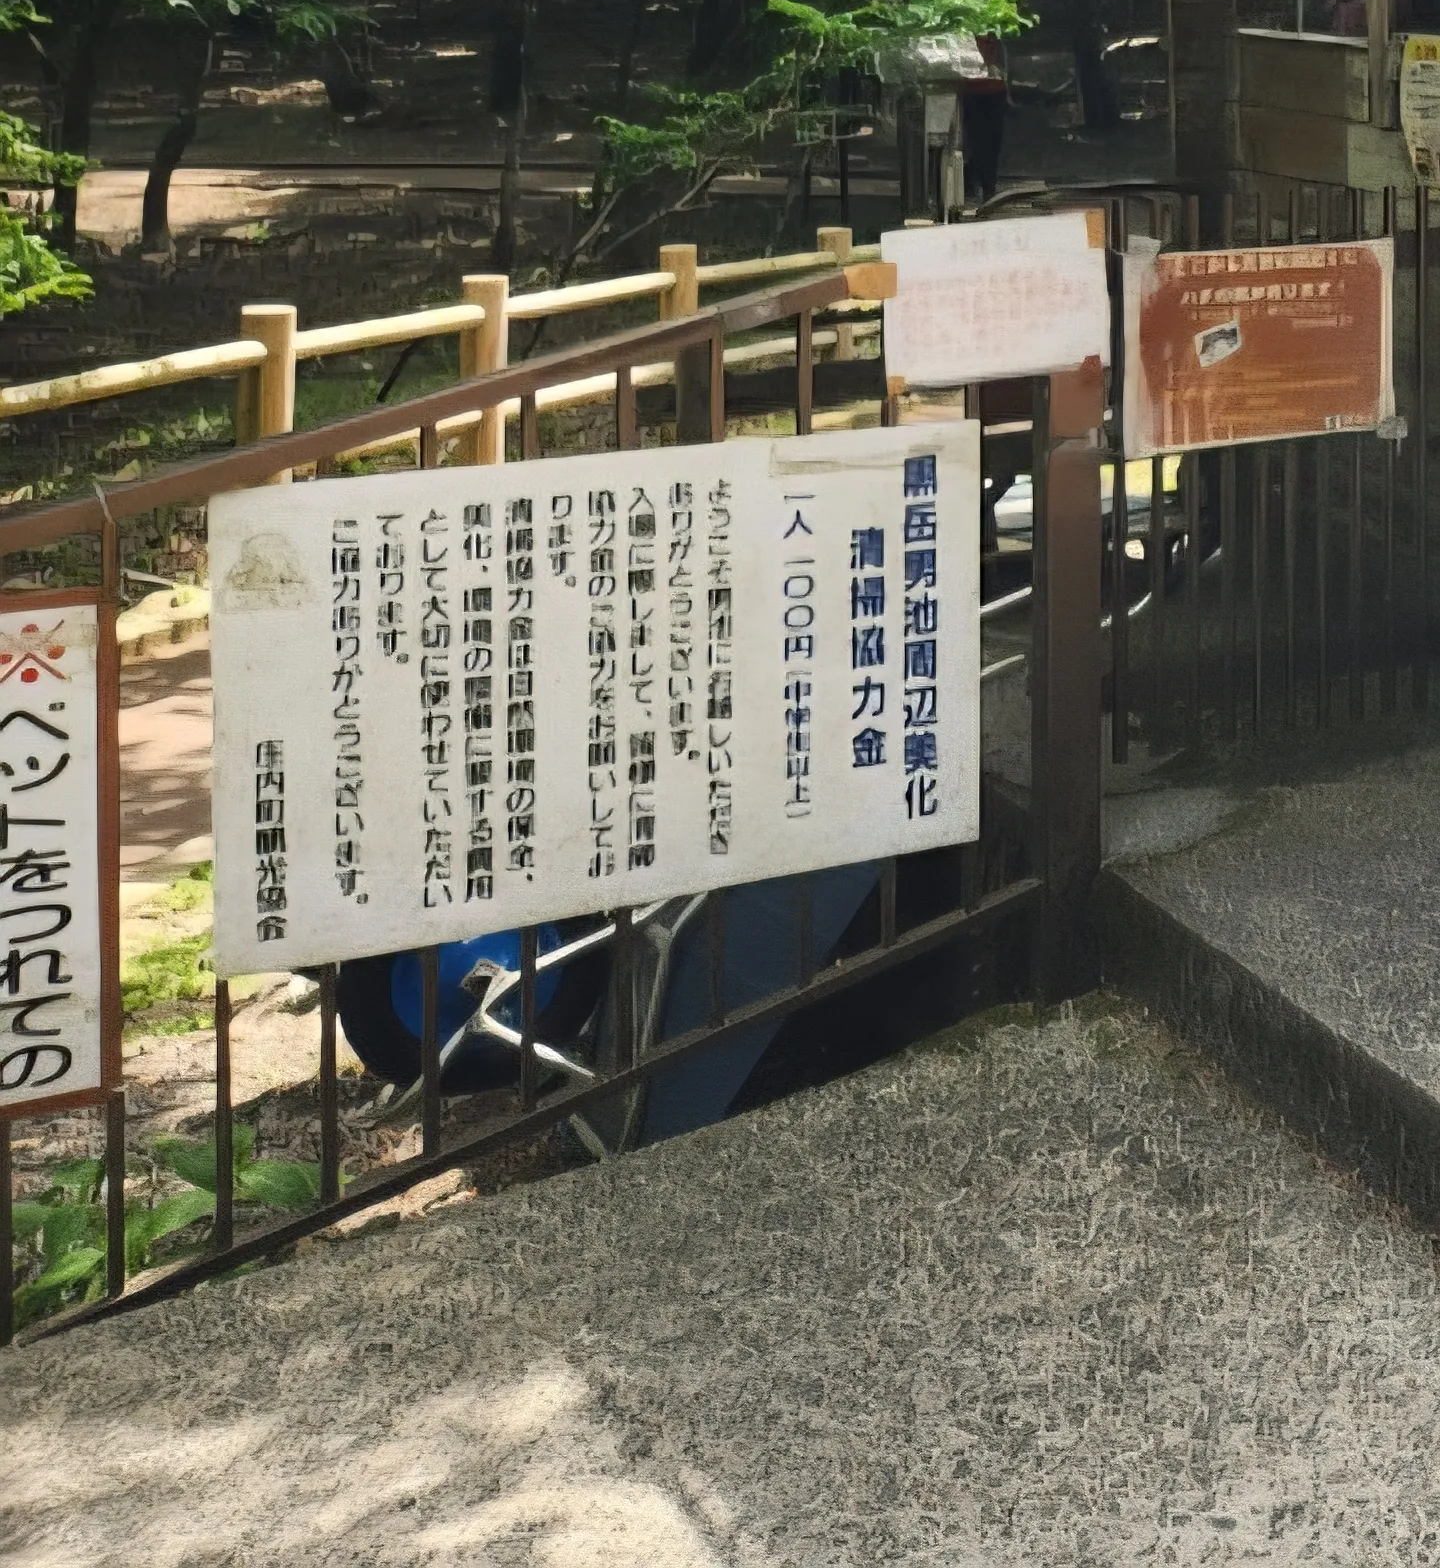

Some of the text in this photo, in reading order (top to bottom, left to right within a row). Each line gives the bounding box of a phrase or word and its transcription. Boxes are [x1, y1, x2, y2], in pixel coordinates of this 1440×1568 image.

[548, 493, 577, 588] ります。
[850, 526, 886, 767] 清掃協力金
[904, 454, 938, 820] 黒岳男池周辺美化
